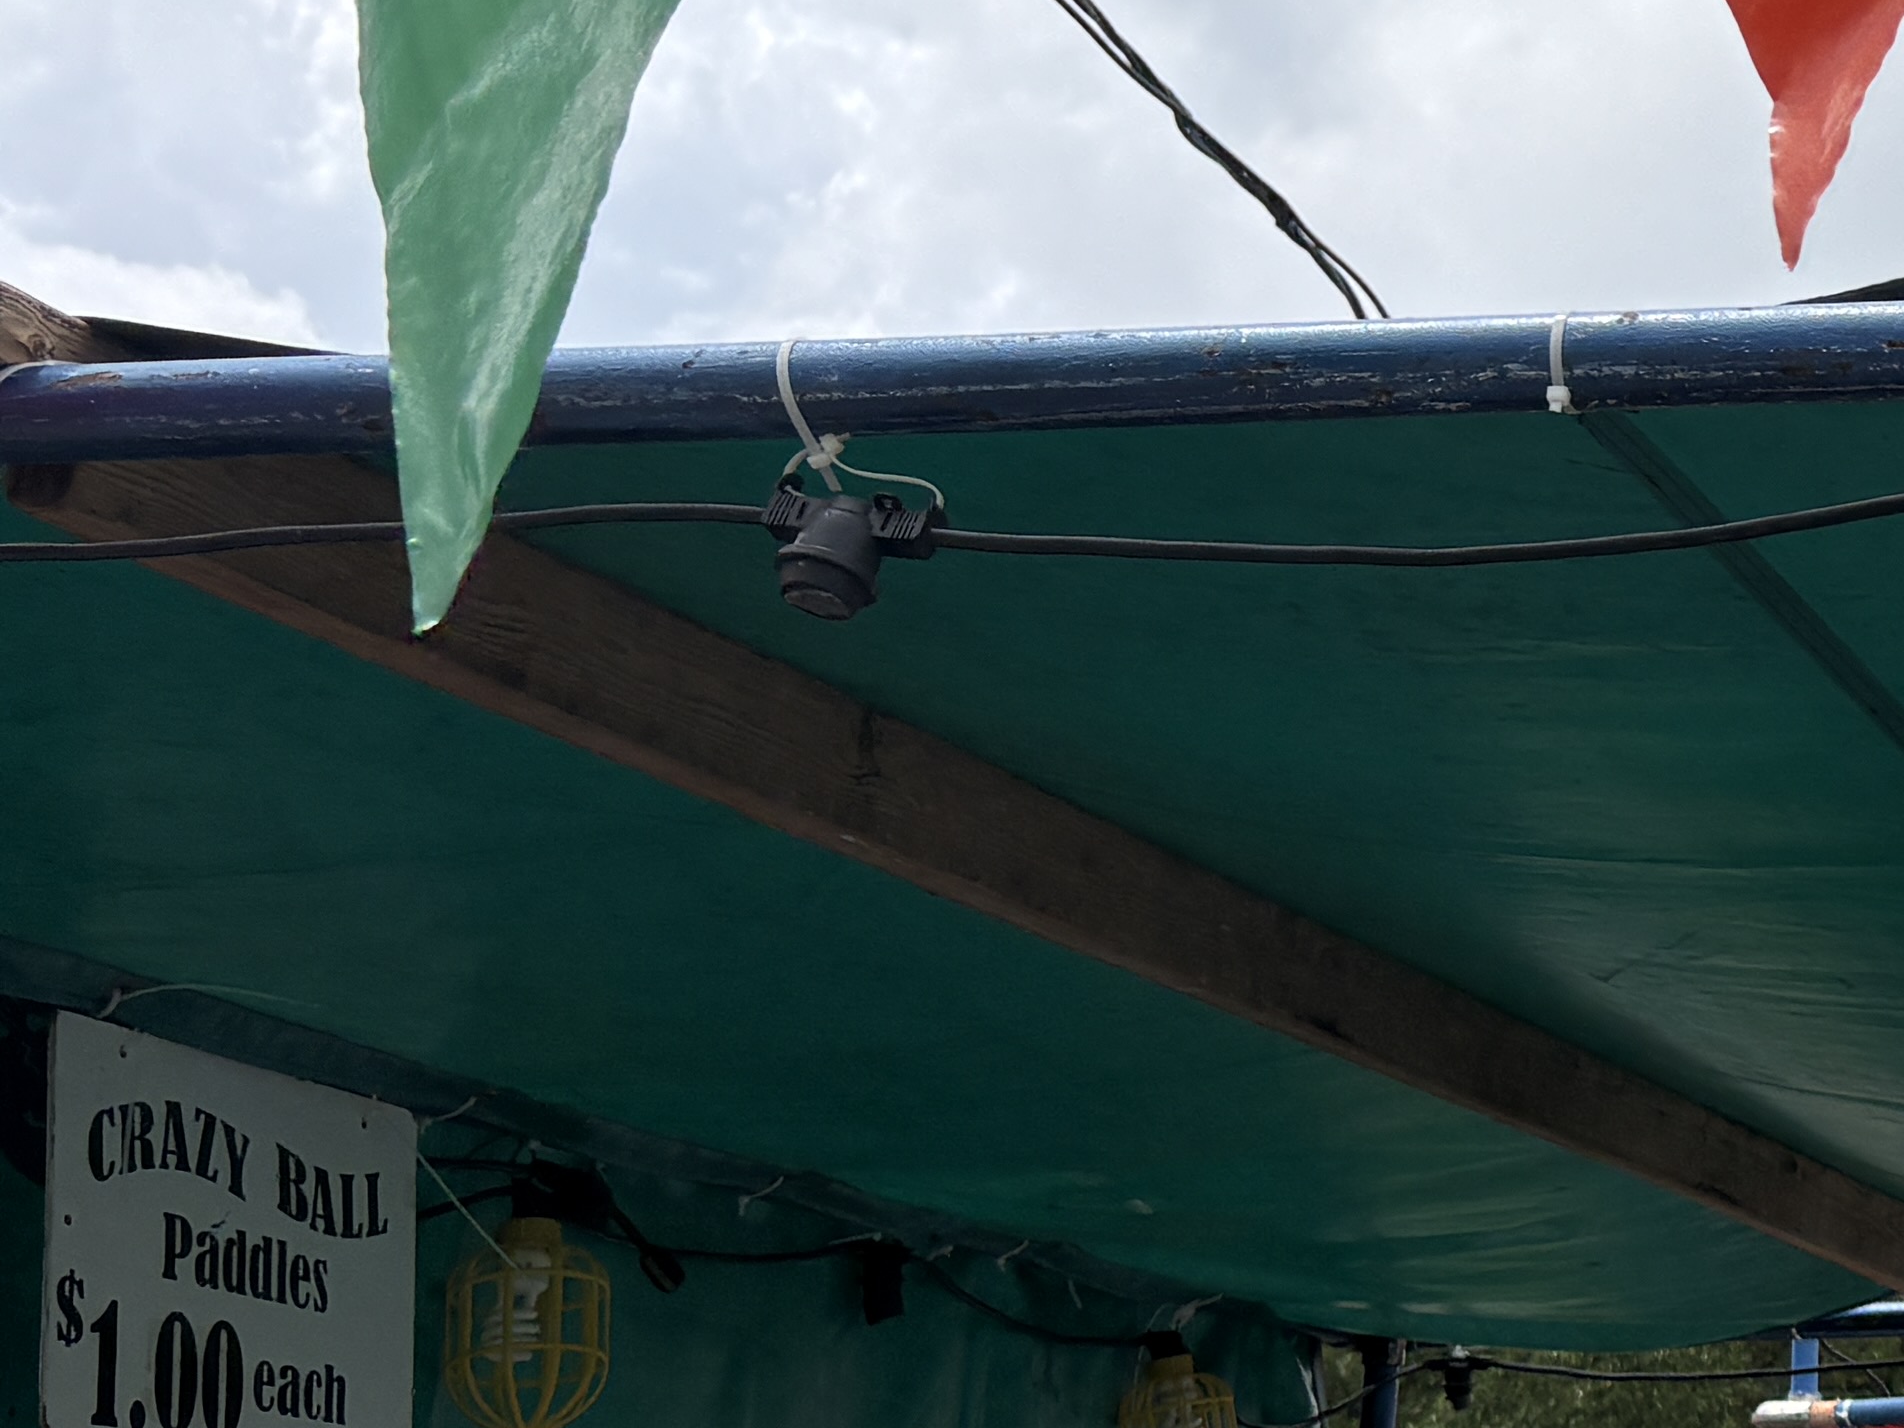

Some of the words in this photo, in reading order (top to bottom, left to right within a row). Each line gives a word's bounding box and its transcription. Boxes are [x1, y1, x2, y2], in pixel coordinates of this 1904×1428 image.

[88, 1100, 250, 1202] CRAZY
[275, 1142, 389, 1239] BALL
[162, 1211, 329, 1314] Paddles
[253, 1359, 347, 1426] each
